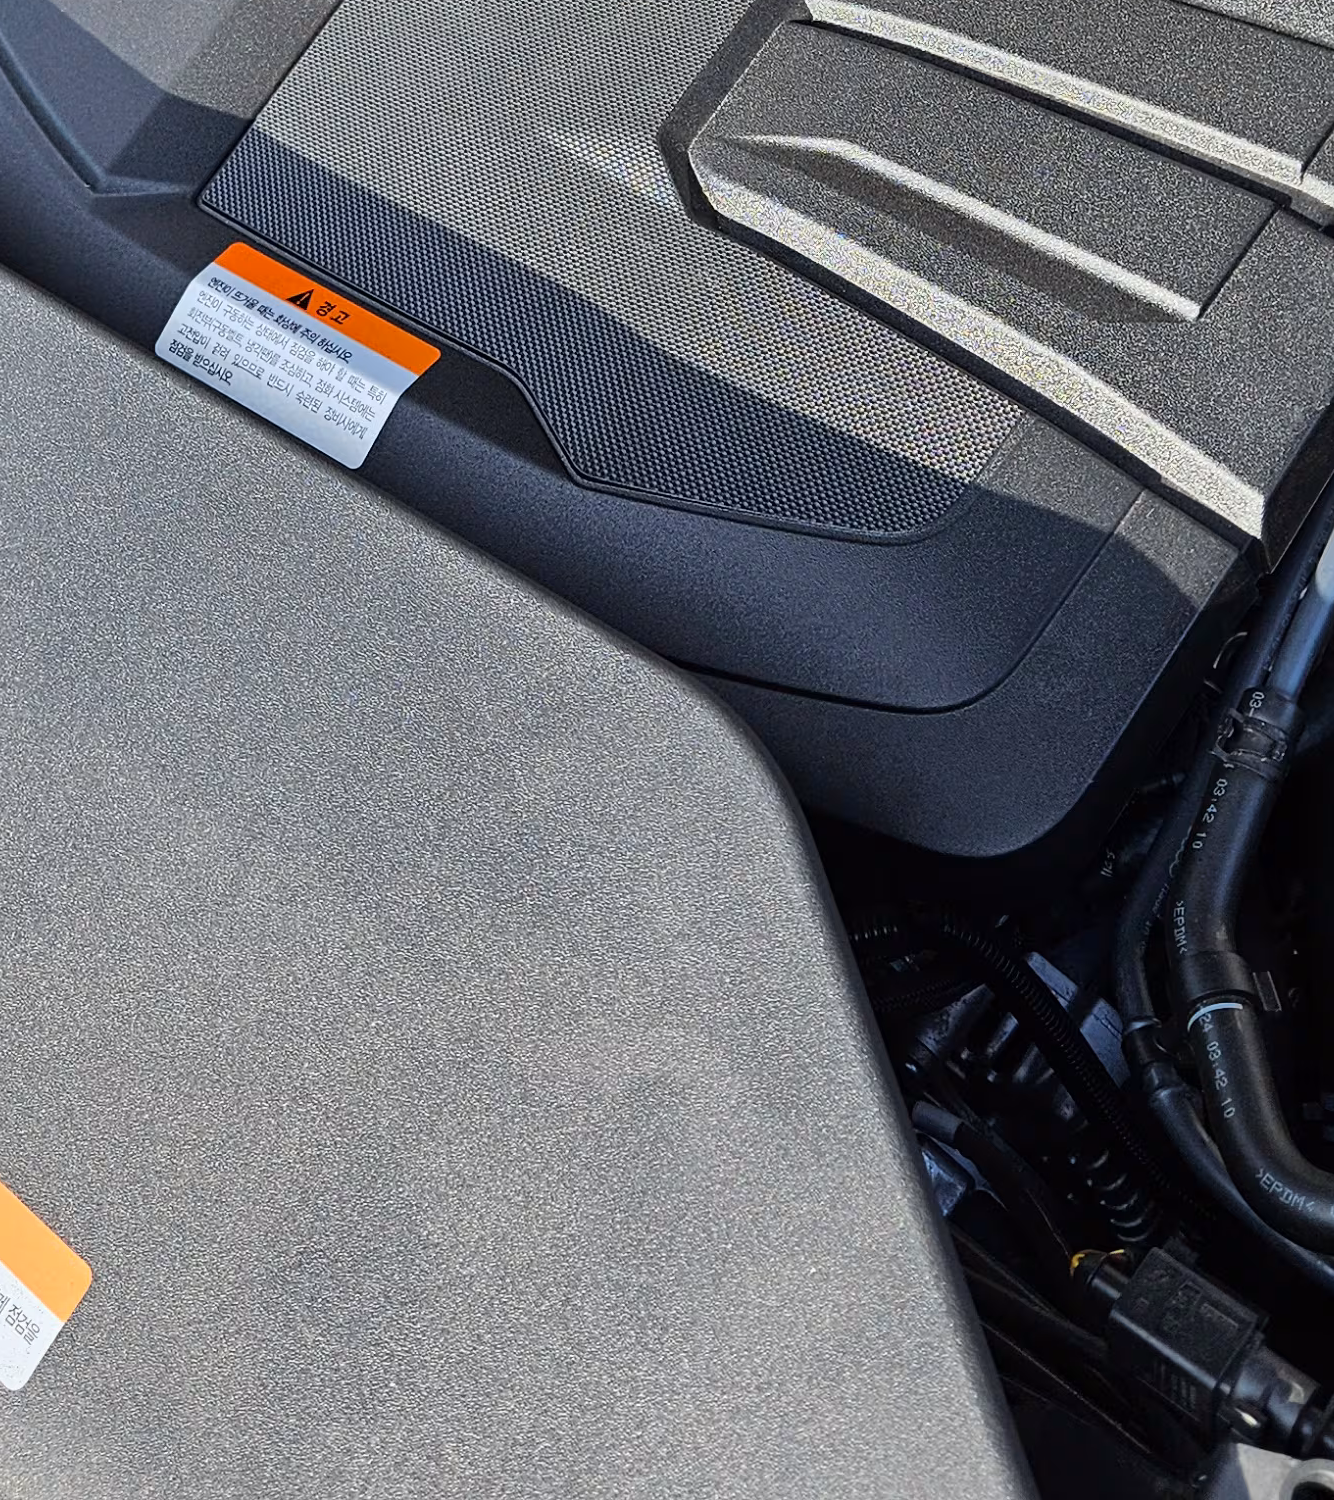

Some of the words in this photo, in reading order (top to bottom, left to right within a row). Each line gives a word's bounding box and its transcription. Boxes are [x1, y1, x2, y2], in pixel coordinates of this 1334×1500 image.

[208, 276, 234, 296] 엔진이
[231, 289, 258, 309] 뜨거울
[256, 304, 275, 319] 때는
[272, 313, 300, 334] 화상에
[298, 327, 319, 344] 주의
[315, 299, 351, 326] 경고
[166, 339, 194, 361] 점검을
[195, 290, 222, 311] 엔진이
[220, 304, 256, 330] 구동하는
[253, 323, 289, 349] 상태에서
[287, 342, 316, 364] 점검을
[314, 356, 336, 375] 해야
[345, 374, 368, 393] 때는
[365, 385, 387, 404] 특히
[176, 323, 210, 349] 고전압이
[210, 343, 230, 360] 걸려
[230, 353, 266, 380] 있으므로
[264, 373, 294, 396] 반드시
[293, 389, 323, 412] 숙련된
[322, 406, 368, 438] 정비사에게
[313, 379, 335, 396] 점화
[331, 389, 378, 421] 시스템에는
[1202, 778, 1228, 823] 03:42
[1192, 832, 1207, 849] 10
[1206, 1040, 1228, 1090] 03:42
[1220, 1097, 1236, 1119] 10
[3, 1301, 42, 1347] 점검을
